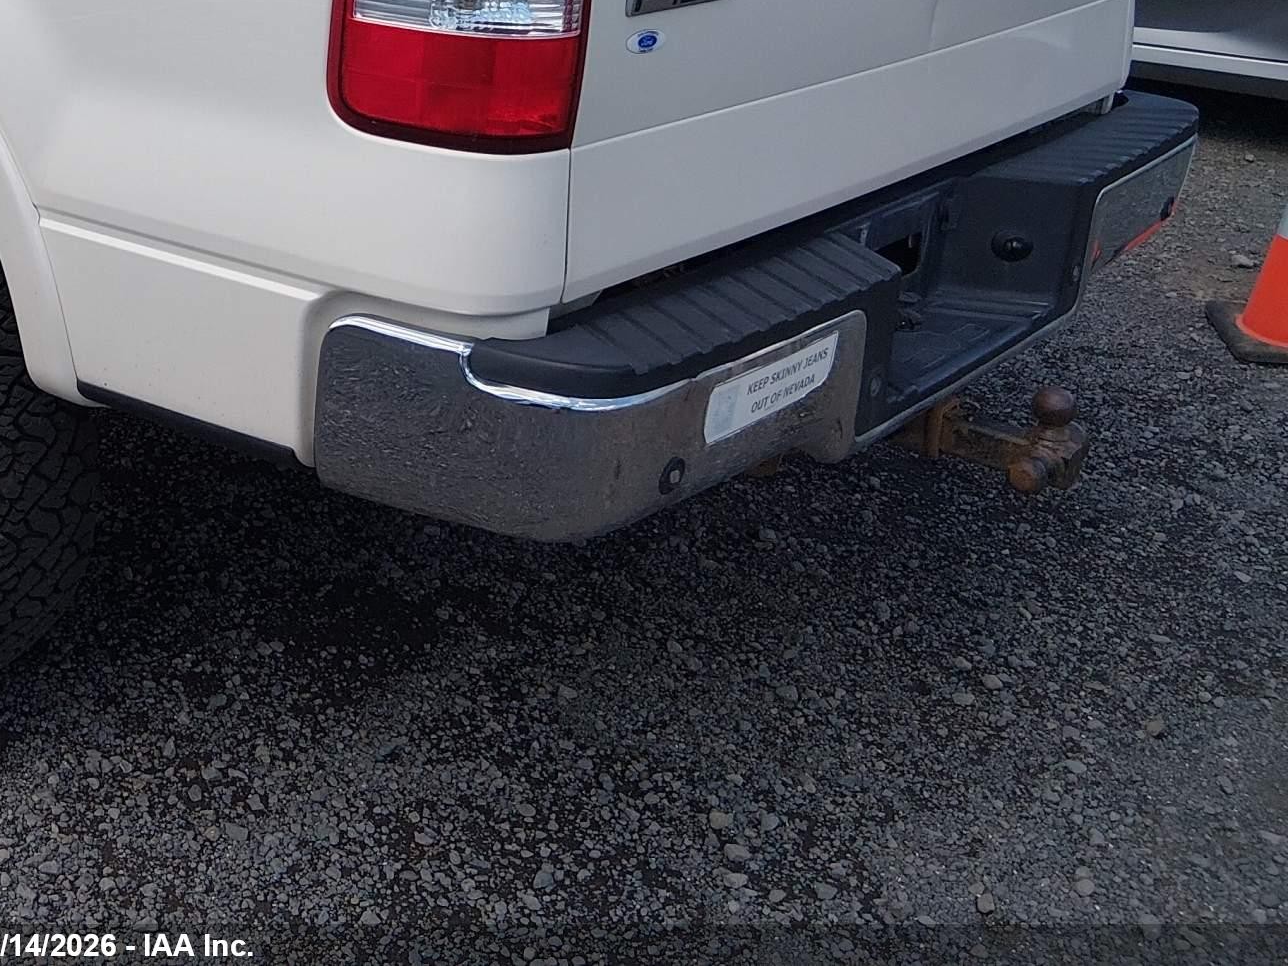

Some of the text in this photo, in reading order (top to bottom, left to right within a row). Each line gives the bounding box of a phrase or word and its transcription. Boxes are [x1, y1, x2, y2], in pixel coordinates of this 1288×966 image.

[746, 347, 829, 395] KEEP SKINNY JEANS
[750, 374, 816, 413] OUT OF NEVADA
